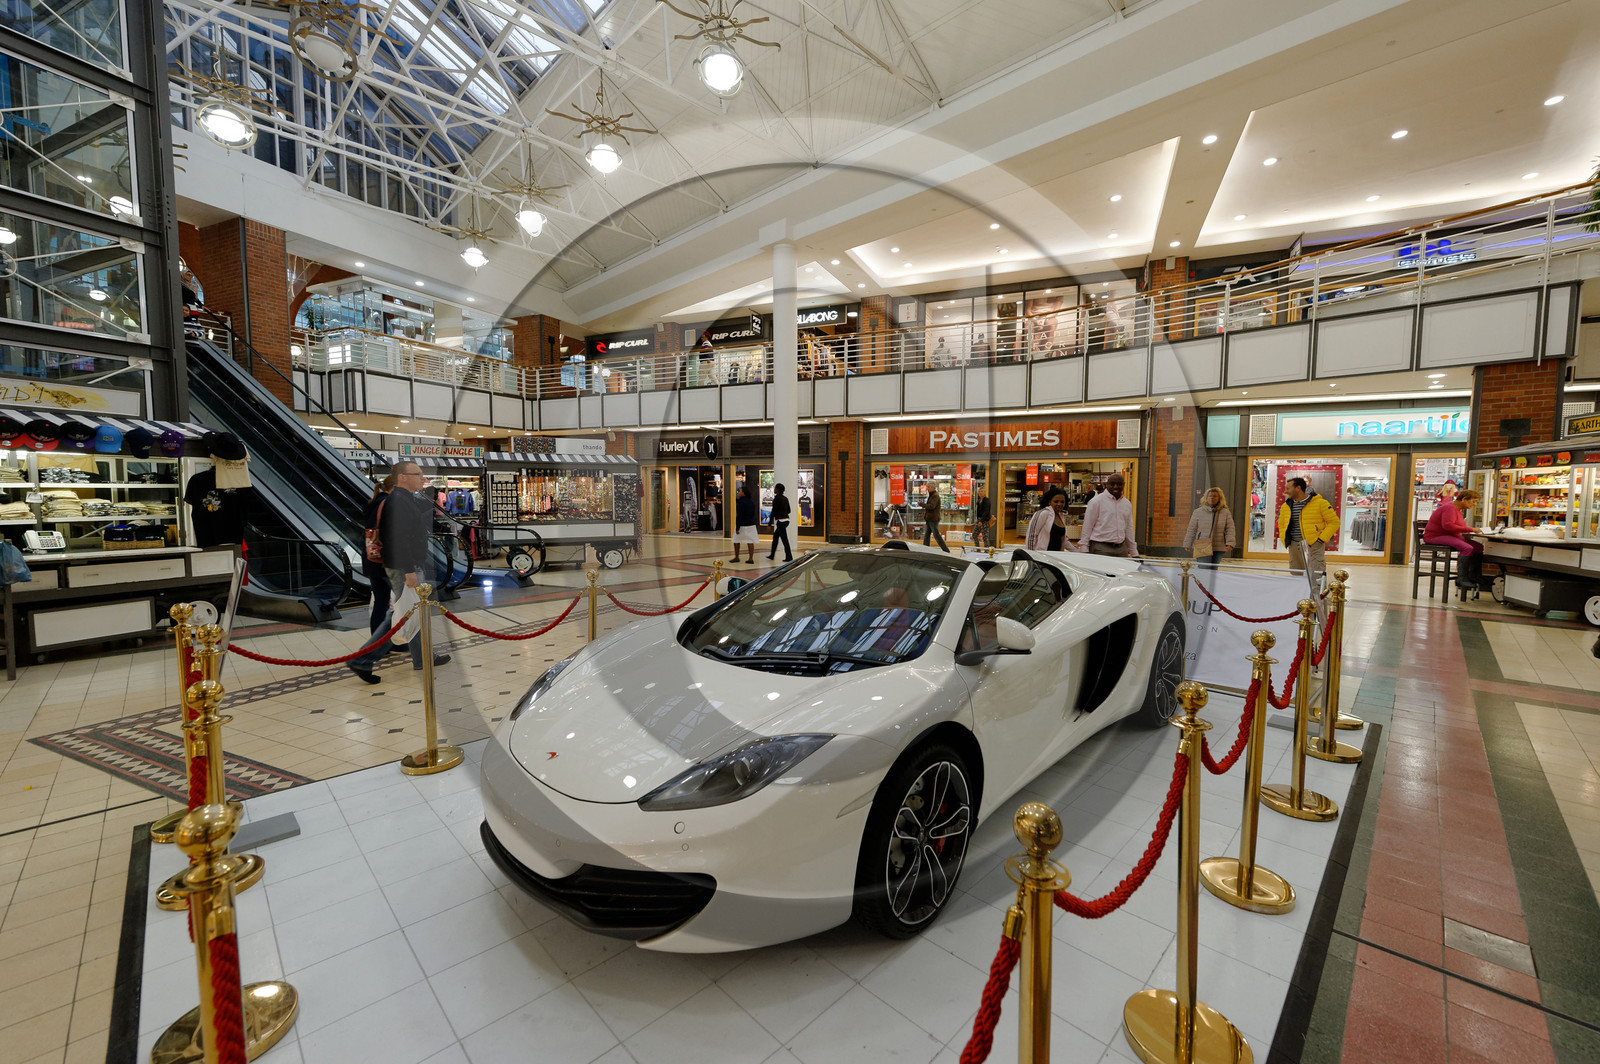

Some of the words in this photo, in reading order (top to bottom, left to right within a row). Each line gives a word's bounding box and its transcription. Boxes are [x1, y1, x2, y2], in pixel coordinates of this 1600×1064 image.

[711, 332, 729, 340] RIP
[729, 330, 756, 338] CURL
[608, 341, 625, 349] RIP
[624, 339, 649, 347] CURL
[929, 429, 1060, 449] PASTIMES
[412, 446, 440, 455] JINGLE
[443, 447, 473, 456] JUNGLE
[659, 440, 689, 453] Hurley
